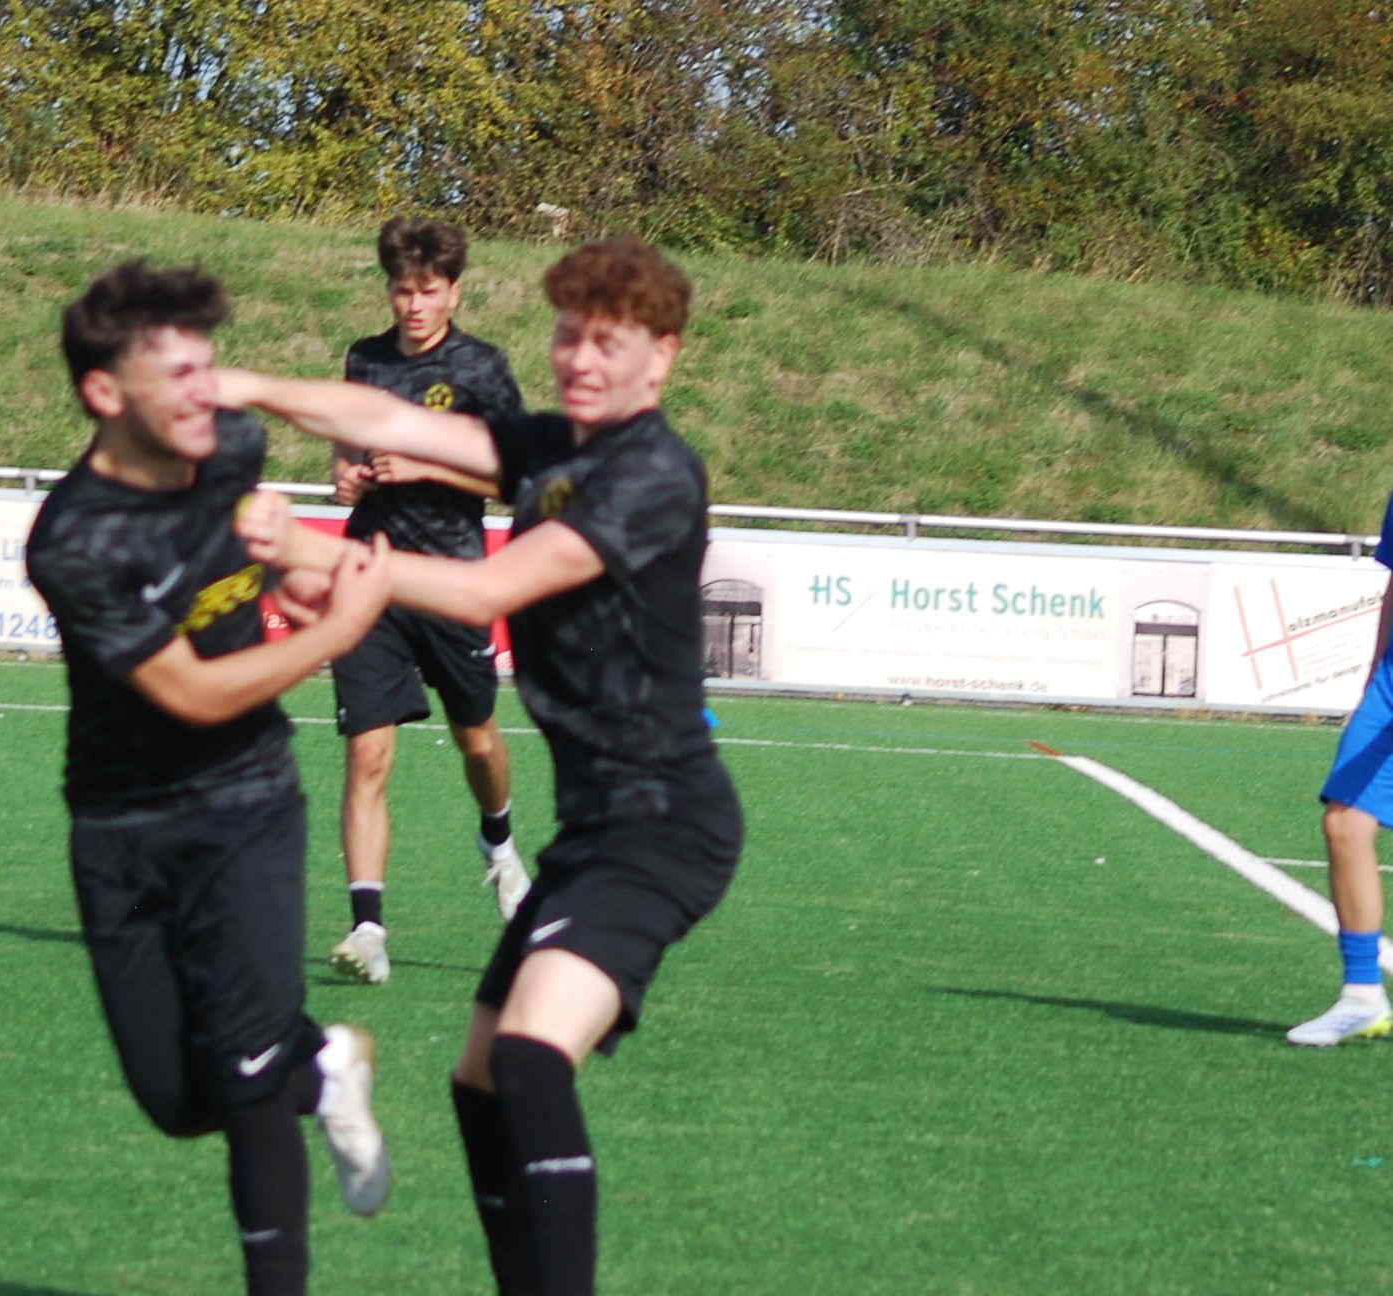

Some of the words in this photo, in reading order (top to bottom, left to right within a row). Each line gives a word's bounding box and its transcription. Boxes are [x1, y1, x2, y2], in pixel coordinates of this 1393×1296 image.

[809, 574, 852, 606] HS
[890, 579, 978, 613] Horst
[991, 583, 1106, 620] Schenk
